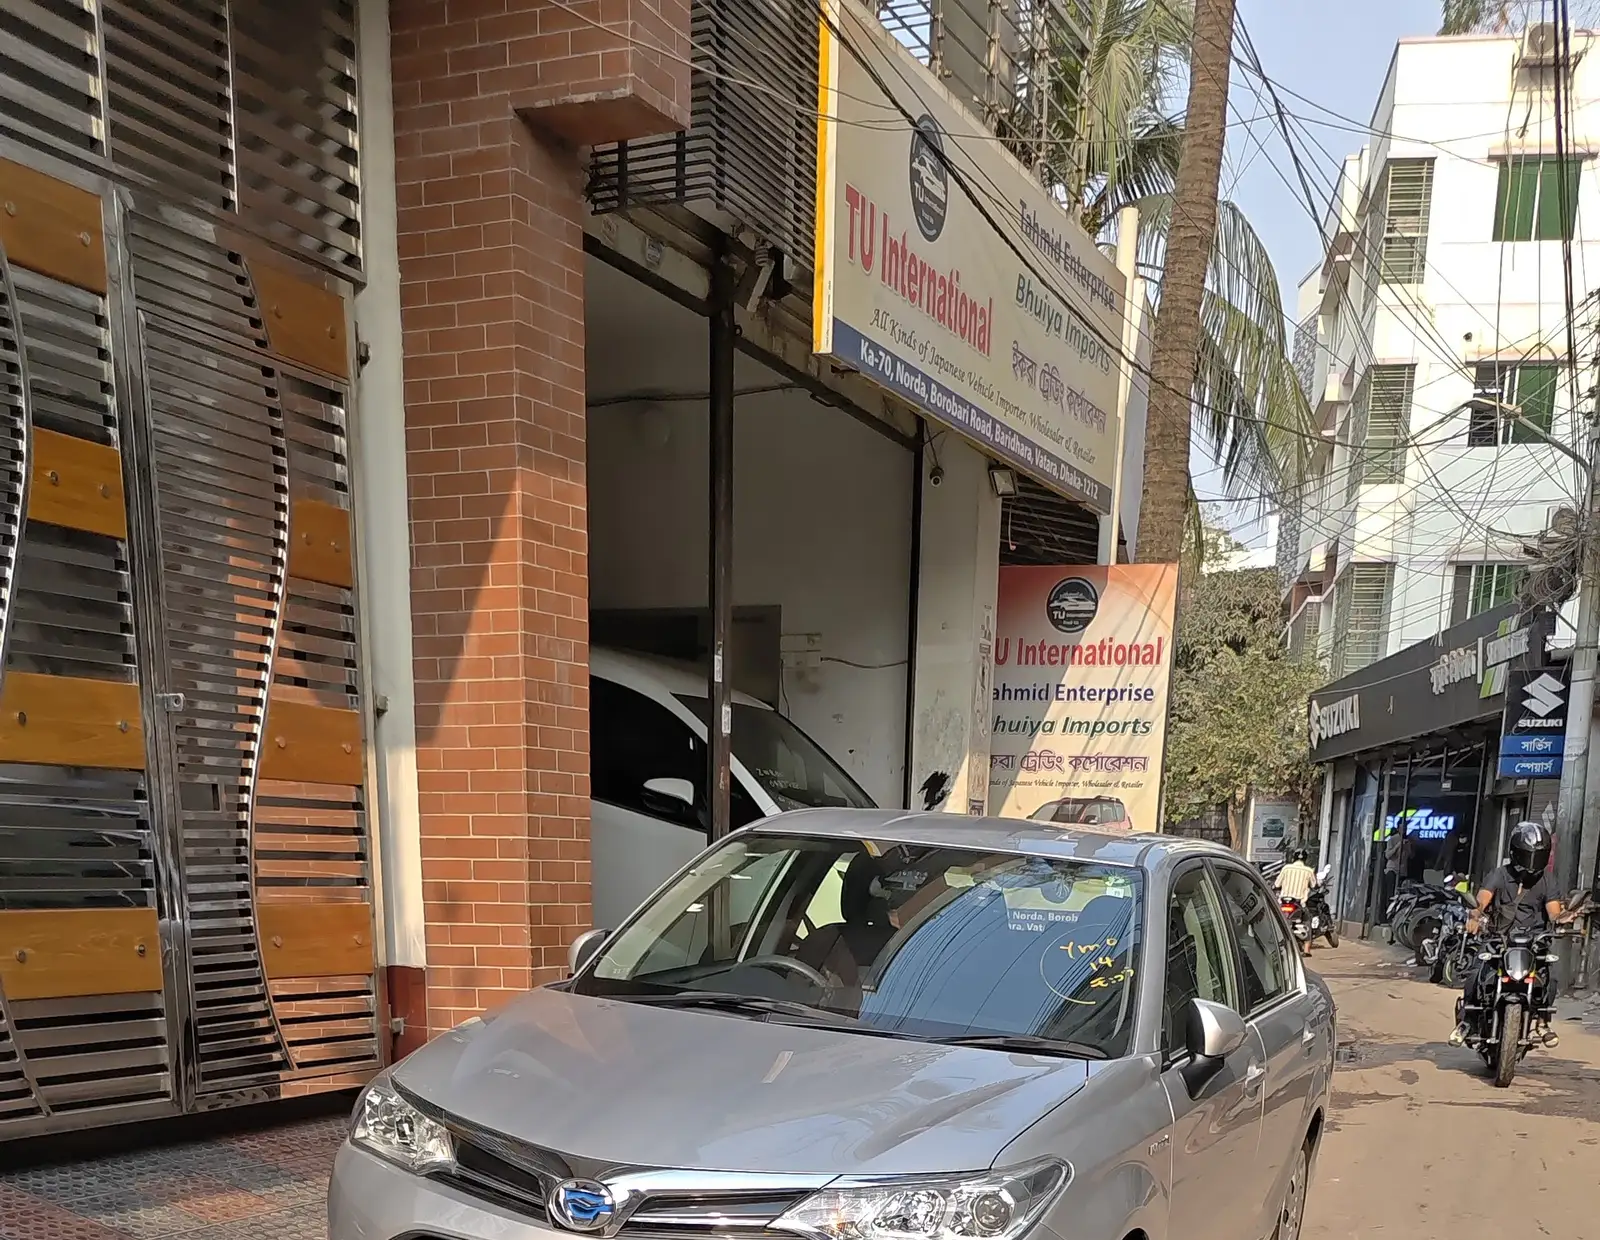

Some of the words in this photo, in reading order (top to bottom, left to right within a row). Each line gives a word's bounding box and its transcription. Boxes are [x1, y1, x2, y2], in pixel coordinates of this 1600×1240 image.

[1020, 199, 1061, 264] Tahmid
[1064, 241, 1115, 312] Enterprise
[845, 182, 875, 272] TU
[881, 212, 992, 357] International
[1016, 273, 1062, 334] Bhuiya
[1065, 315, 1110, 372] Imports
[870, 309, 889, 332] All
[889, 319, 918, 351] Kinds
[919, 340, 930, 362] of
[928, 345, 966, 382] Japanese
[967, 371, 995, 402] Vehicle
[996, 390, 1027, 426] Importer,
[1029, 411, 1064, 446] Wholesaler
[860, 339, 894, 381] Ka-70,
[896, 361, 928, 402] Norda,
[930, 382, 970, 424] Borobari
[970, 408, 994, 441] Road,
[994, 422, 1034, 463] Baridhara,
[1034, 447, 1059, 479] Vatara,
[1060, 464, 1098, 500] Dhaka-1212
[1053, 610, 1066, 620] TU
[995, 637, 1009, 666] U
[1017, 637, 1163, 666] International
[993, 683, 1050, 701] ahmid
[1055, 683, 1154, 706] Enterprise
[992, 715, 1056, 737] huiya
[1061, 716, 1152, 738] Imports
[1320, 694, 1360, 740] SUZUKI
[1518, 718, 1563, 728] SUZUKI
[1521, 738, 1553, 753] সার্ভিস
[1020, 750, 1064, 772] ট্রেডিং
[1068, 752, 1148, 772] কর্পোরেশন
[1419, 830, 1448, 838] SERVIC
